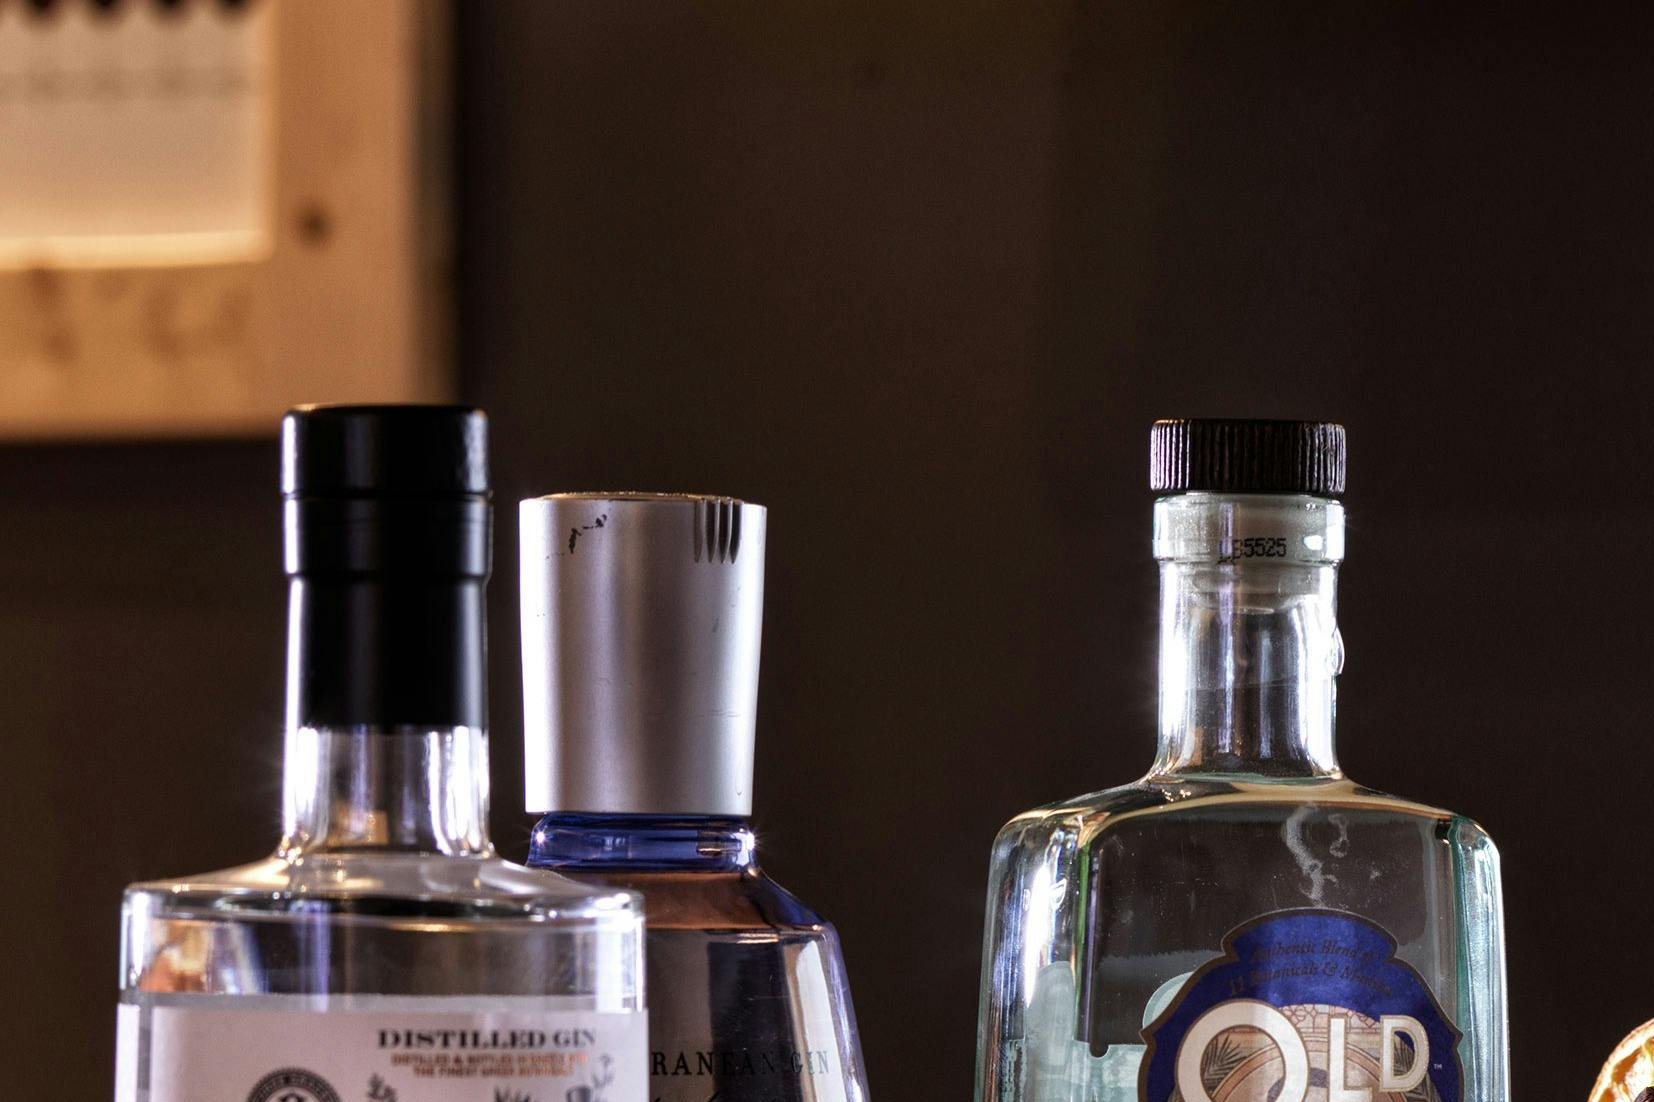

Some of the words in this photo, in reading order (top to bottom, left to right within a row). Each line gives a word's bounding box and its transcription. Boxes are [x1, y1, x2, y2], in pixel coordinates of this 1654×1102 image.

[377, 1029, 546, 1049] DISTILLED
[552, 1028, 596, 1048] GIN
[791, 1050, 831, 1075] GIN
